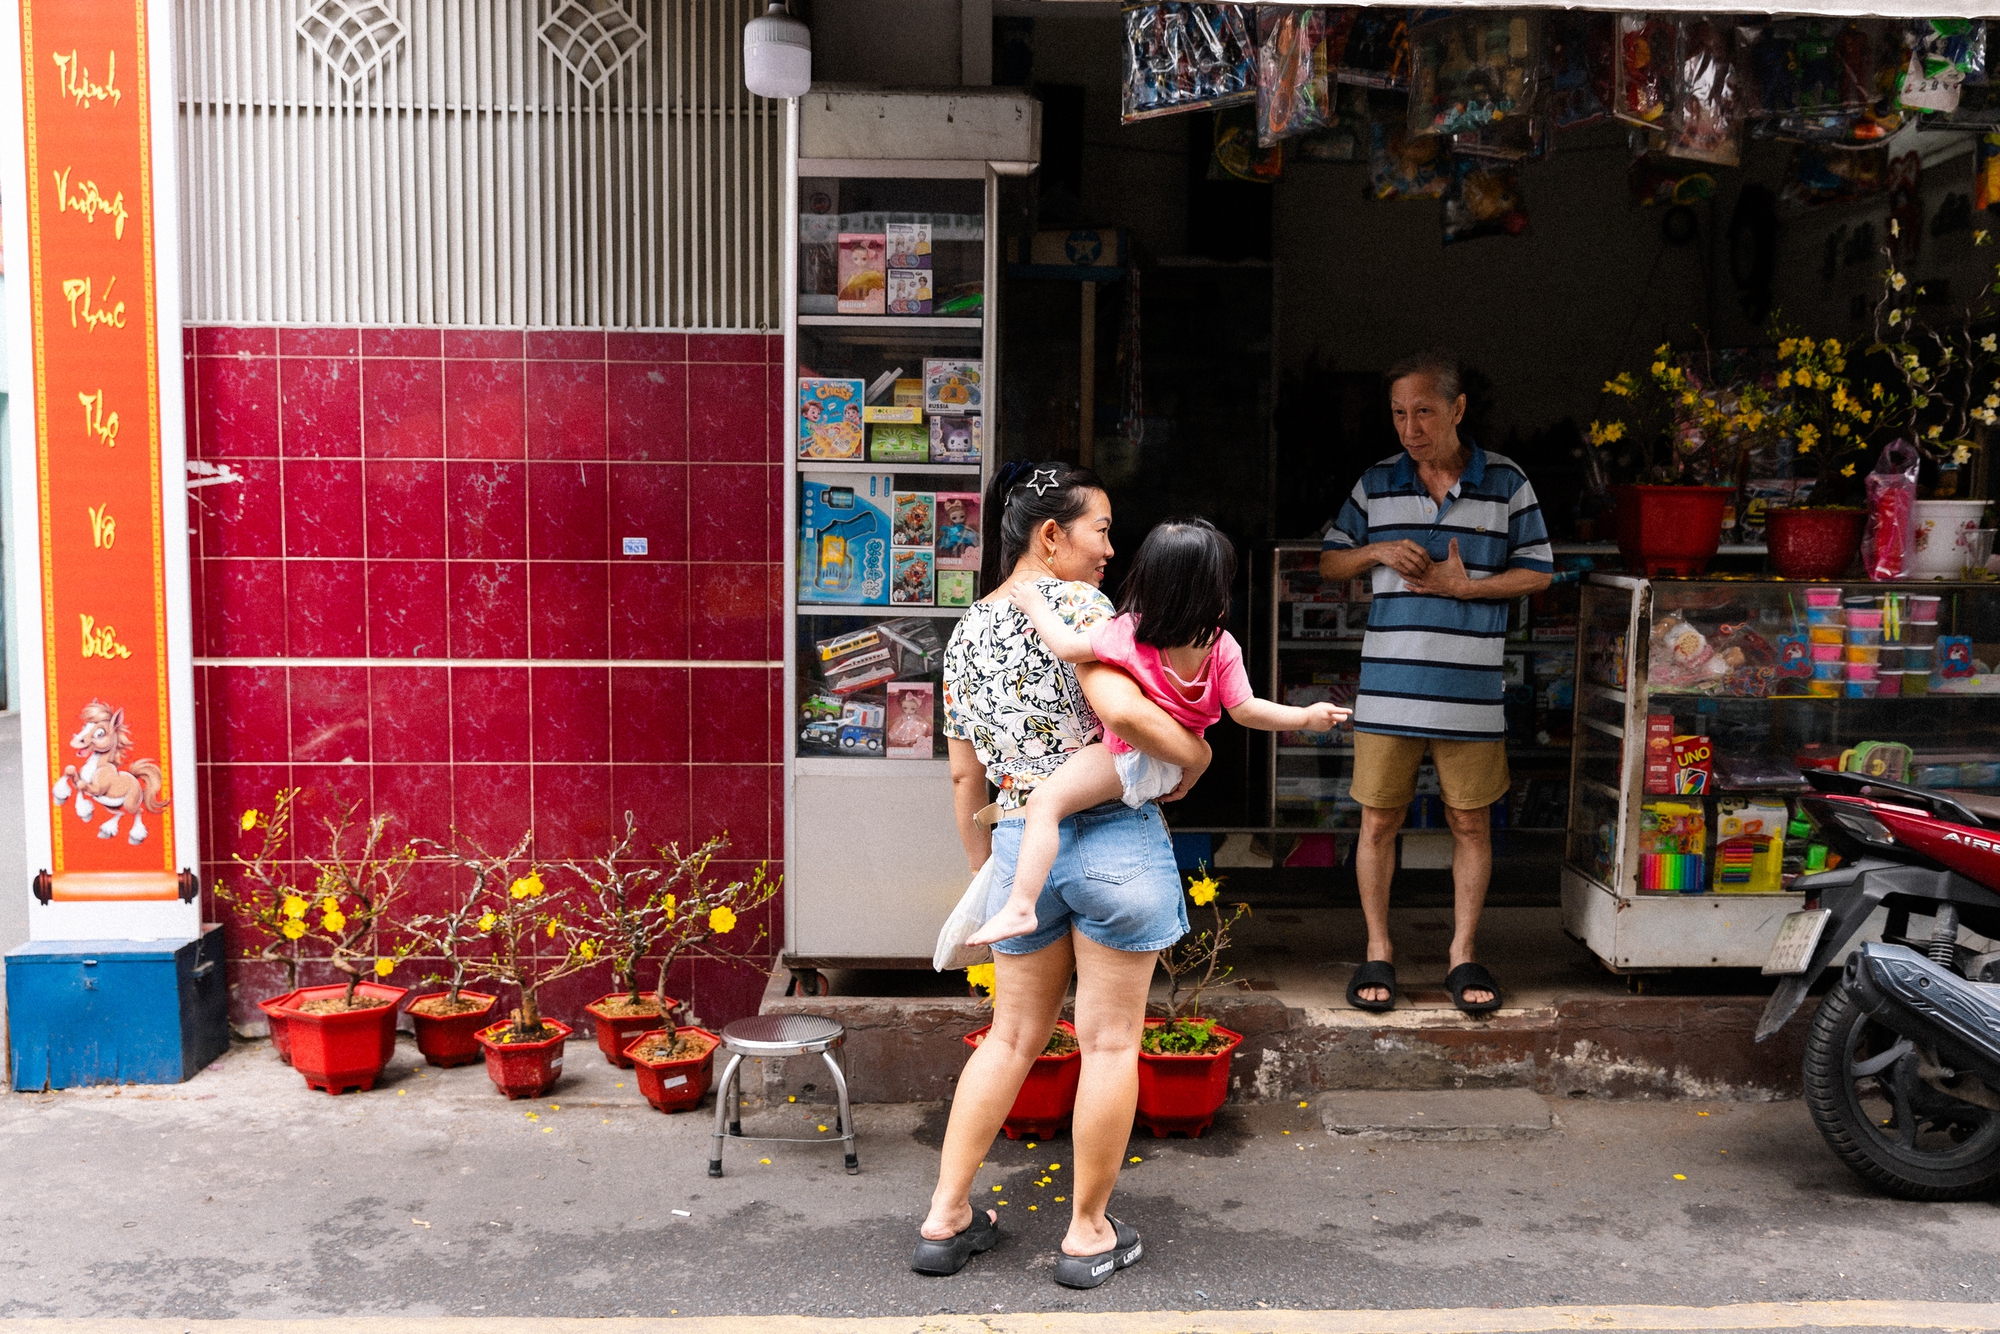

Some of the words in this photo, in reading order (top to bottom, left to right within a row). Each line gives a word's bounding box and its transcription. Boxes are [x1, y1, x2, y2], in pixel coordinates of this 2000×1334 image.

[52, 48, 122, 109] Thịnh
[62, 275, 127, 334] Phúc
[78, 388, 120, 448] Thọ
[88, 502, 117, 550] Vô
[79, 613, 133, 661] Biên
[1677, 746, 1711, 767] UNO
